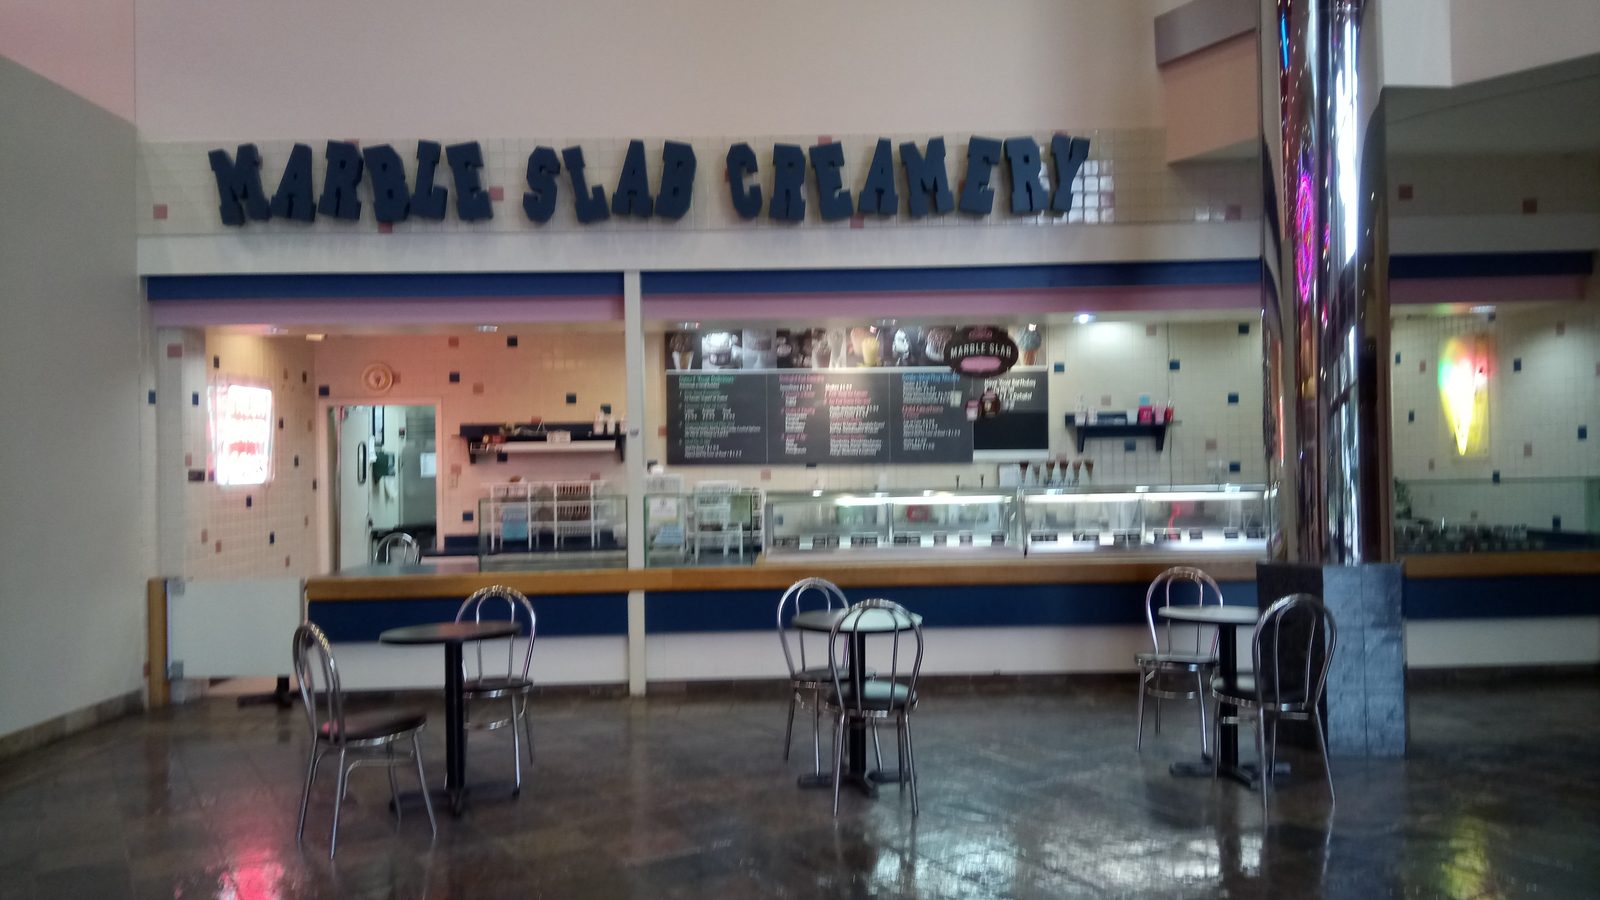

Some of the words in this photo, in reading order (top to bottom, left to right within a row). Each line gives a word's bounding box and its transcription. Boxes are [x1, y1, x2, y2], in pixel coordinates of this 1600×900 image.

[208, 139, 494, 226] MARBLE
[523, 139, 697, 225] SLAB
[726, 134, 1091, 222] CREAMERY
[950, 341, 986, 360] MARBLE
[989, 342, 1012, 359] SLAB
